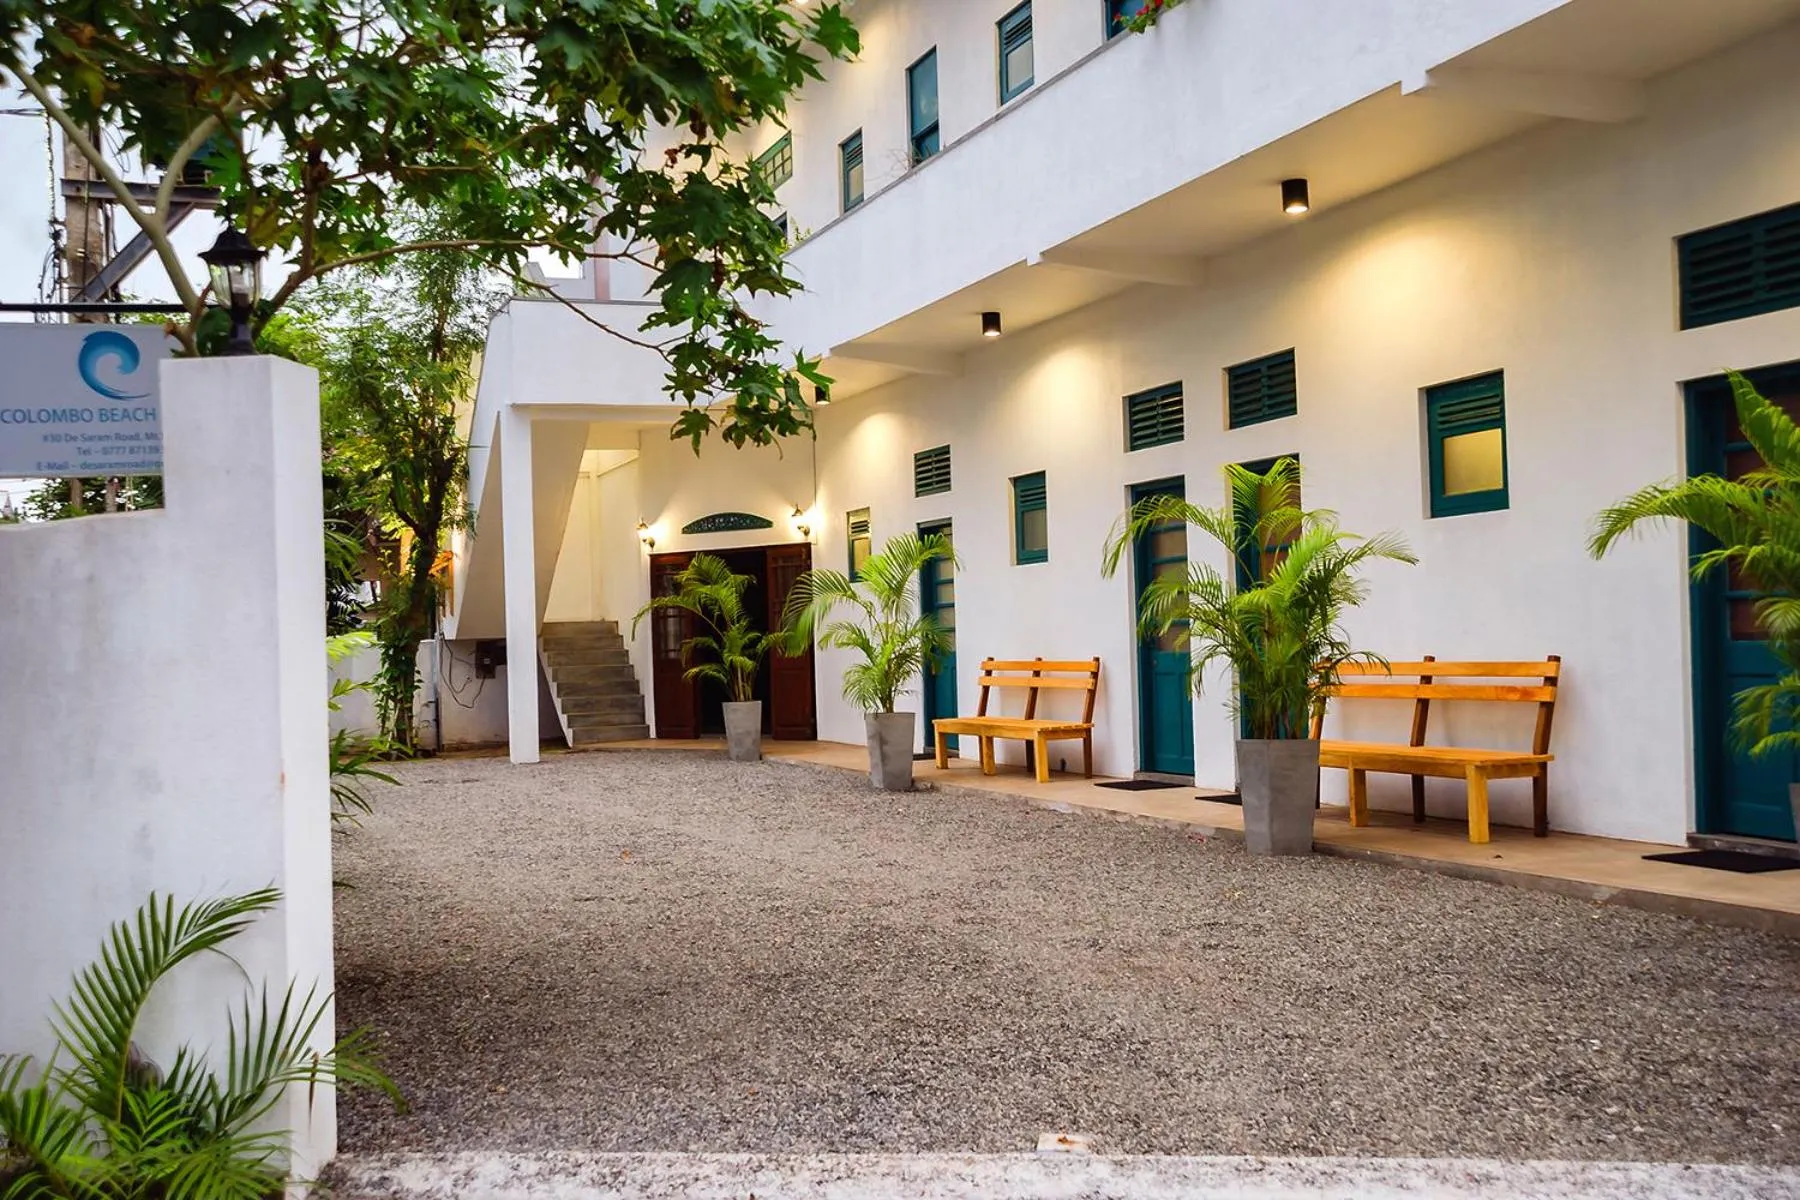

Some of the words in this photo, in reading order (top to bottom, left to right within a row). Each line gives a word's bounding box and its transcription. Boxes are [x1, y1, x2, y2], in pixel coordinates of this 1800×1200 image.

[1, 408, 94, 424] COLOMBO
[99, 407, 157, 423] BEACH
[64, 433, 79, 443] De
